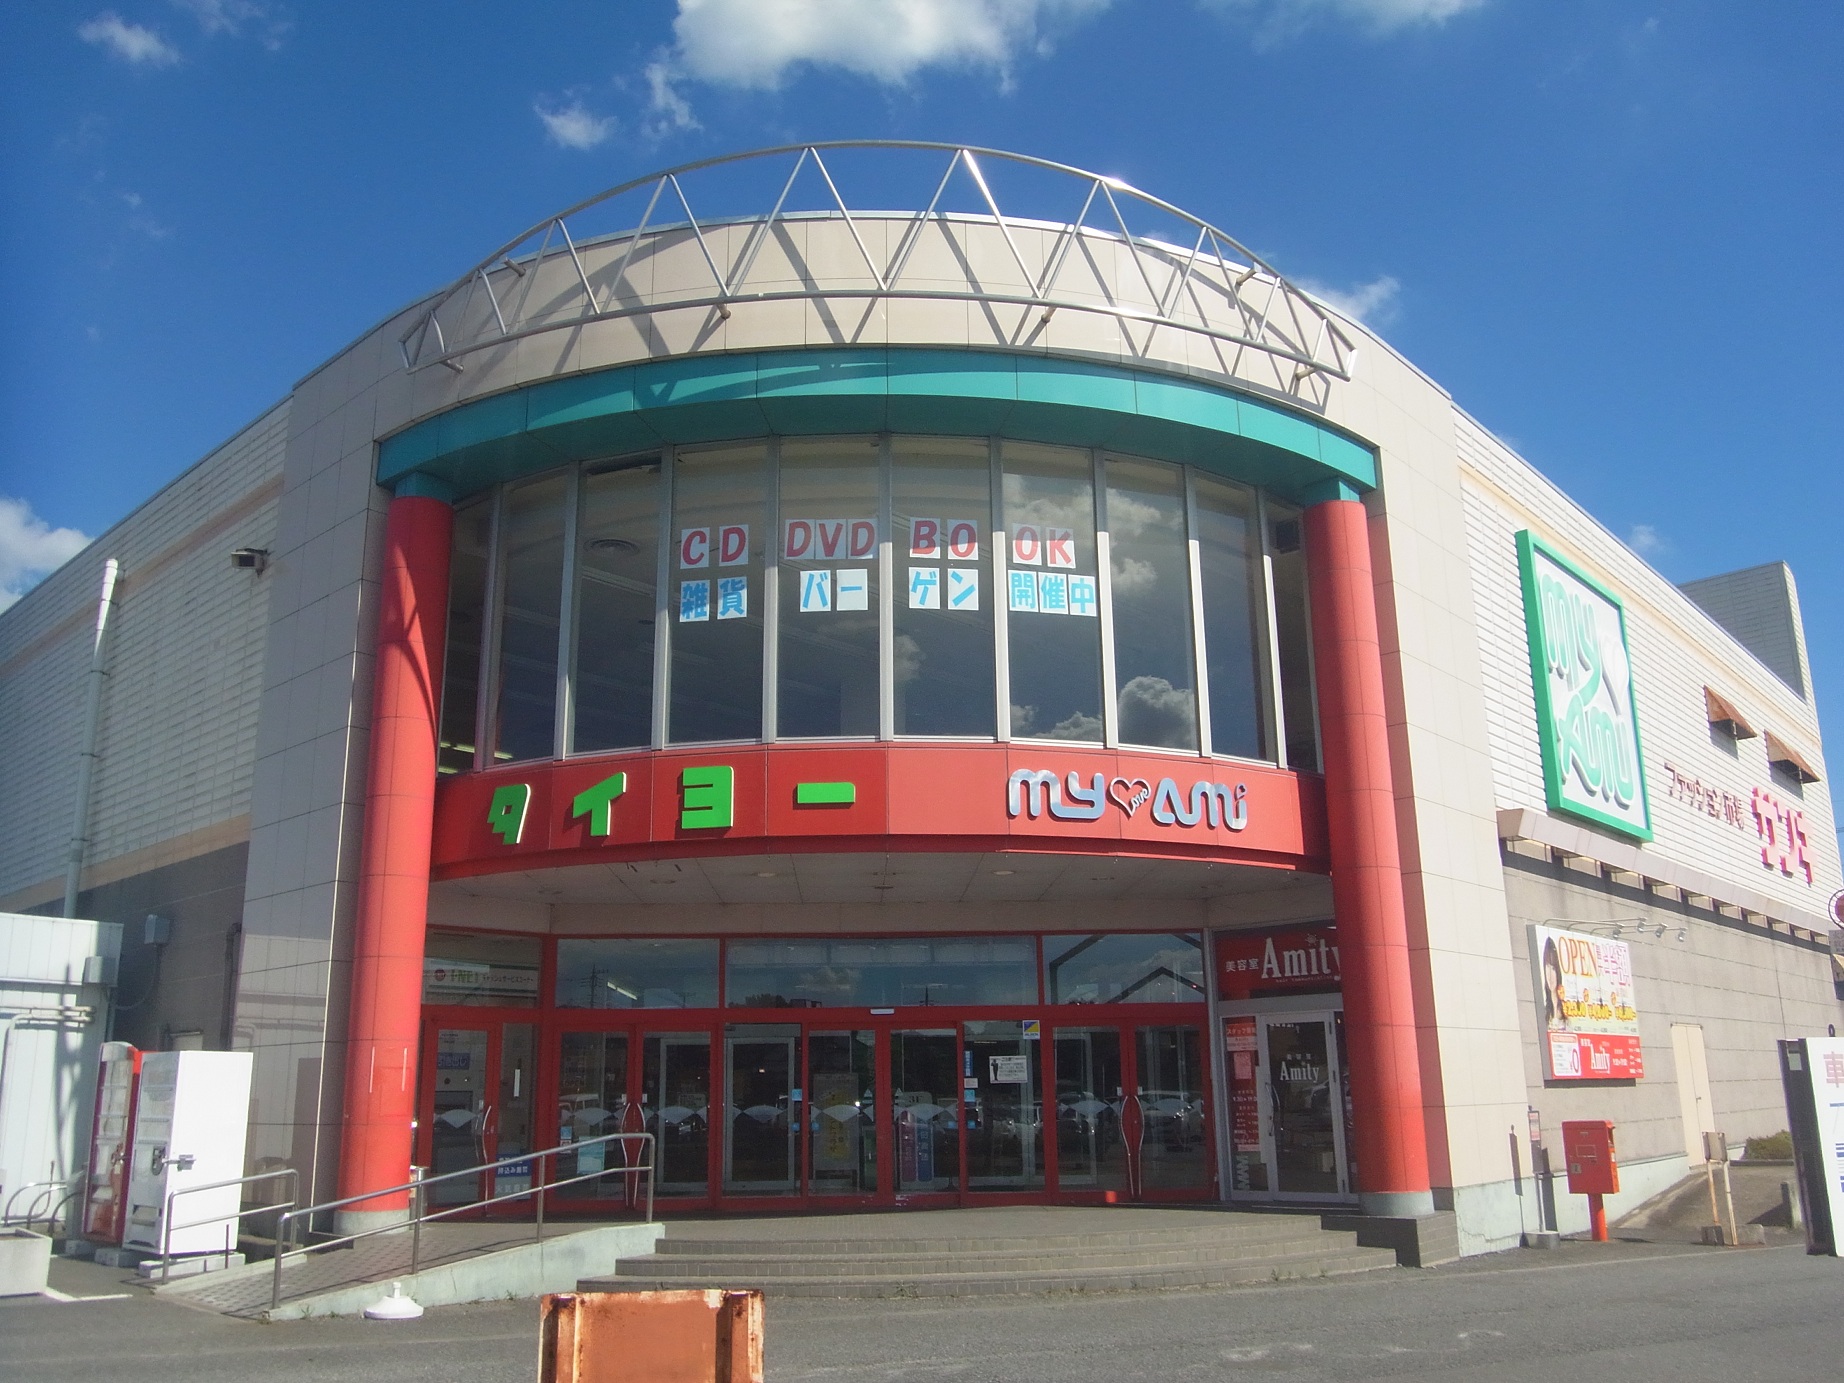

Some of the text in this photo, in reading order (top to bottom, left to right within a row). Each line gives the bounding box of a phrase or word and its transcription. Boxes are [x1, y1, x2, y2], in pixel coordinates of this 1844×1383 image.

[682, 527, 747, 565] CD
[785, 520, 876, 558] DVD
[1009, 571, 1095, 615] 開催中
[486, 765, 856, 845] タイヨー
[1226, 958, 1259, 973] 美容室
[1558, 936, 1598, 978] OPEN
[1280, 1061, 1319, 1083] Amity
